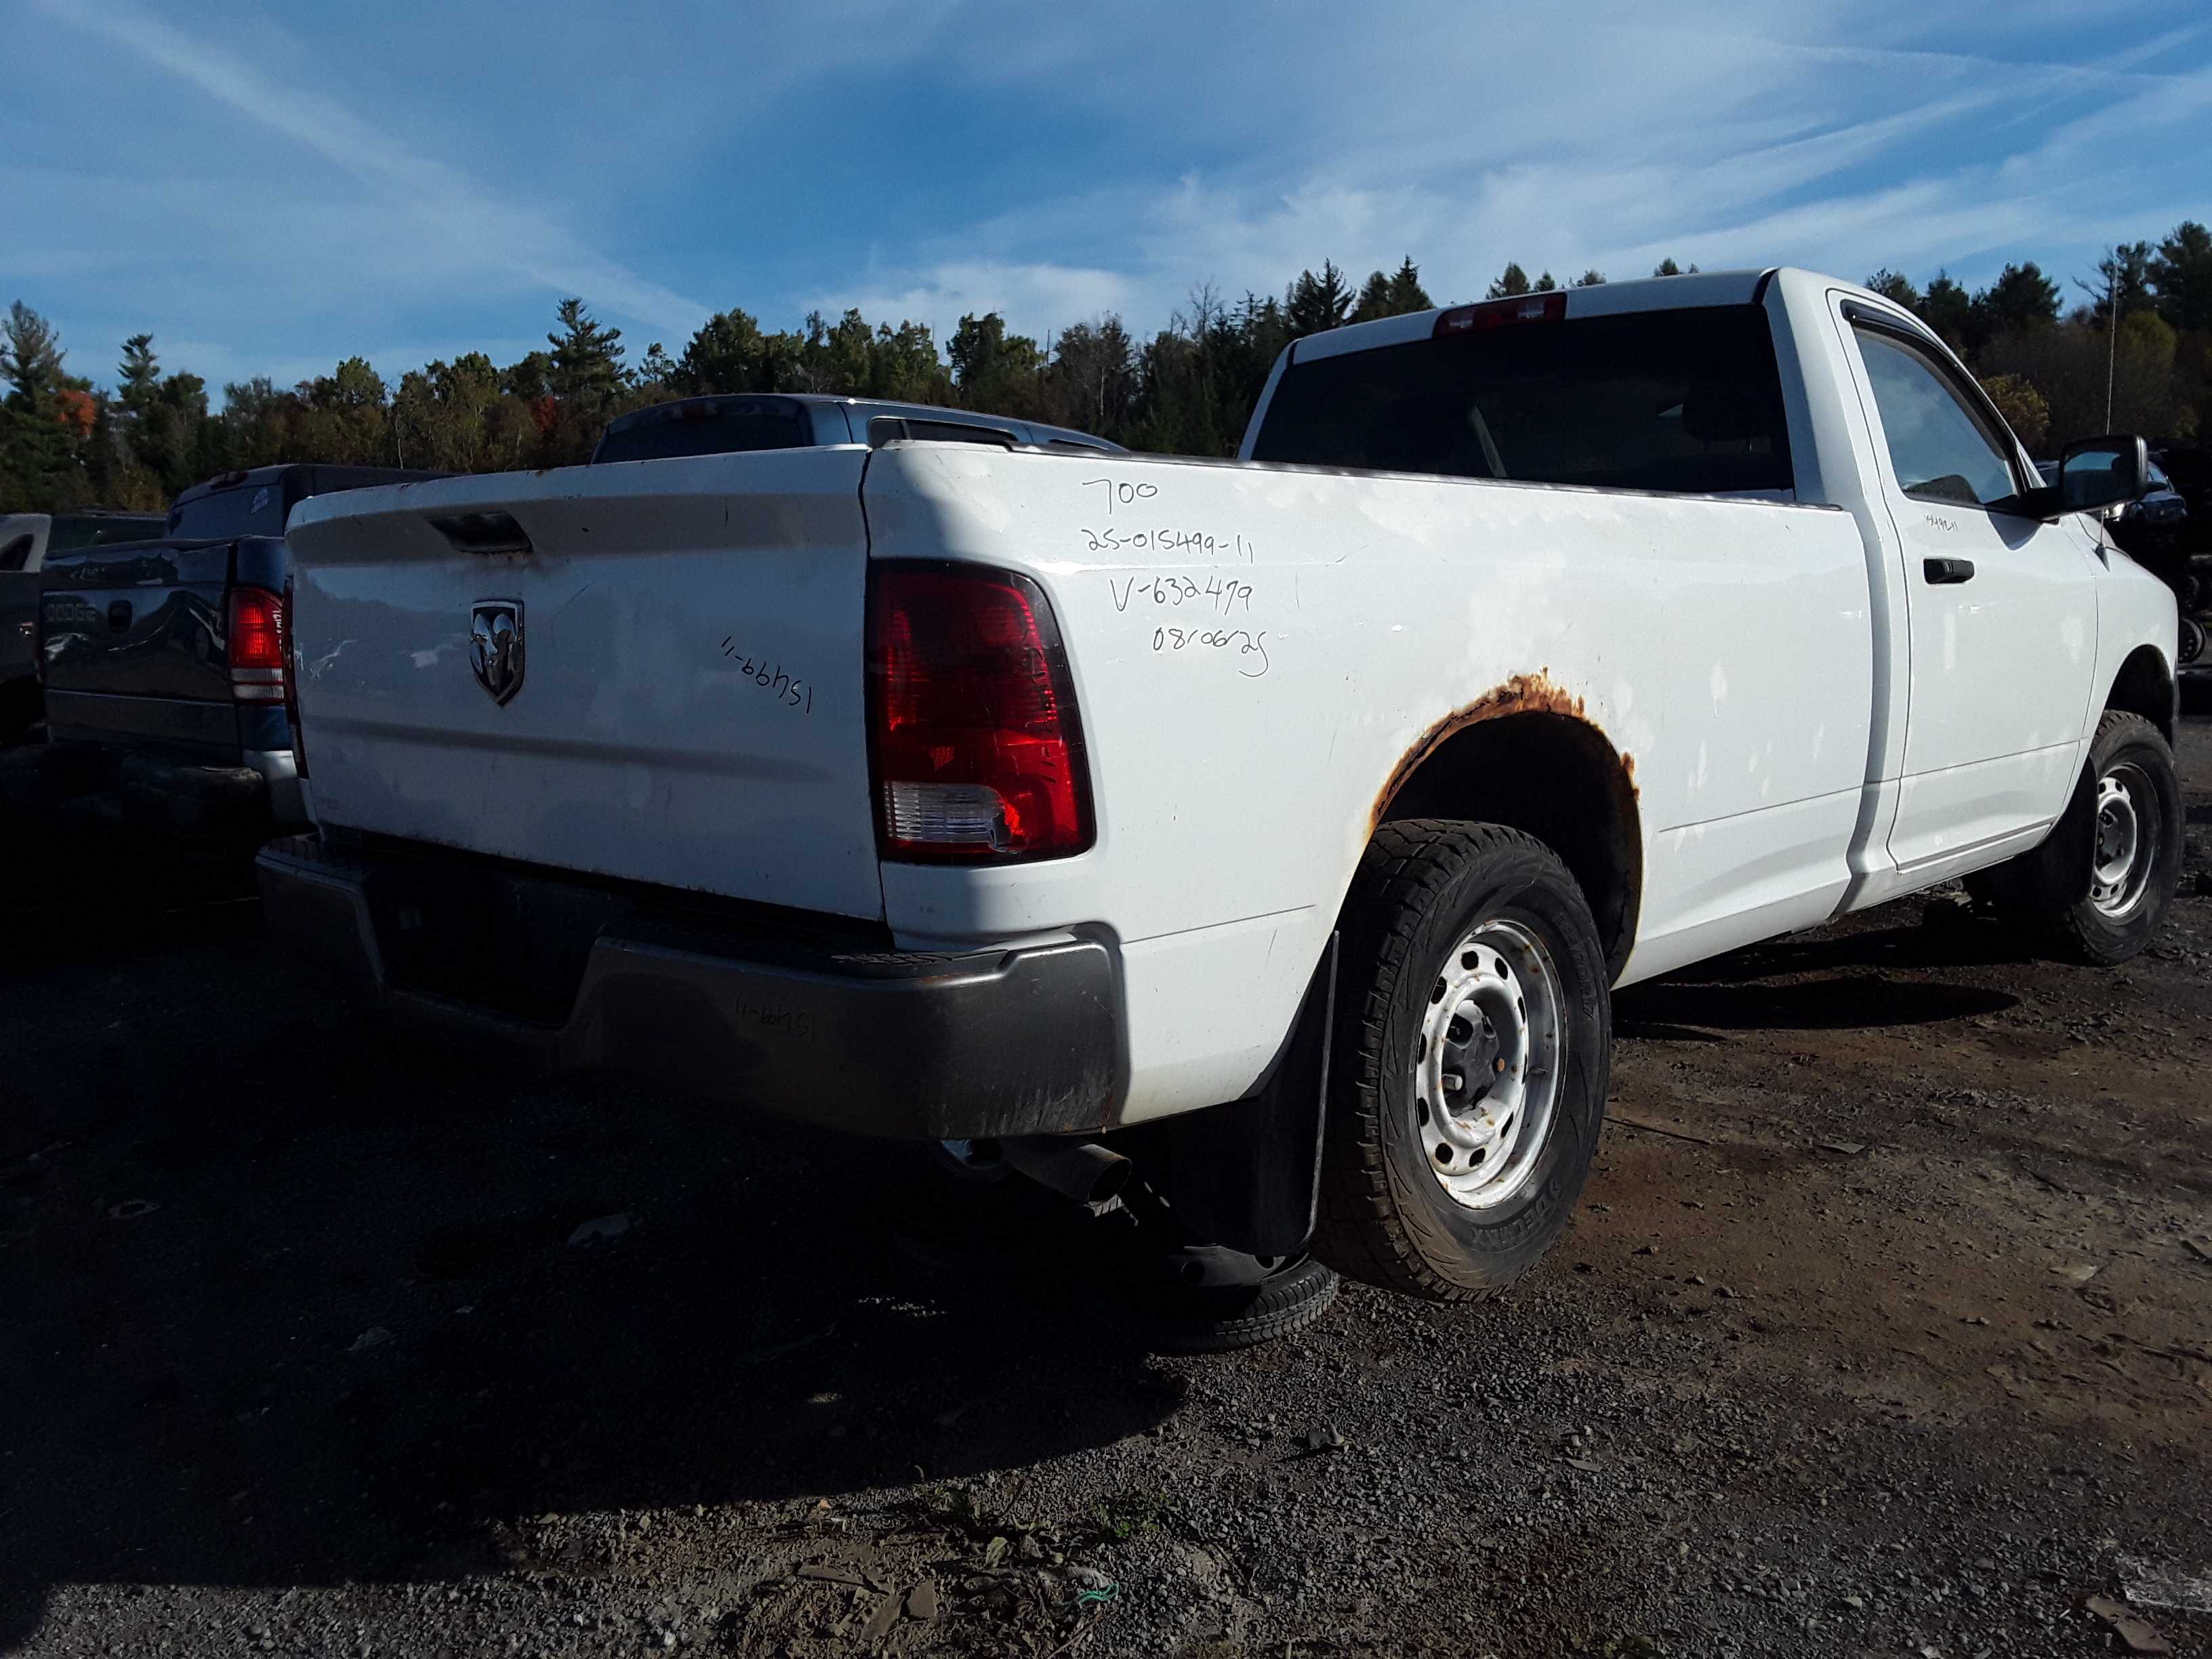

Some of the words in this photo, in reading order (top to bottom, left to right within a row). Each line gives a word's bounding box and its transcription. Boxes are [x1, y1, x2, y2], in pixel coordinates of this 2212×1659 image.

[1082, 478, 1158, 514] 700
[1080, 528, 1253, 564] 25-015499-11
[1109, 575, 1252, 615] V-632479
[720, 635, 812, 714] 15499-11
